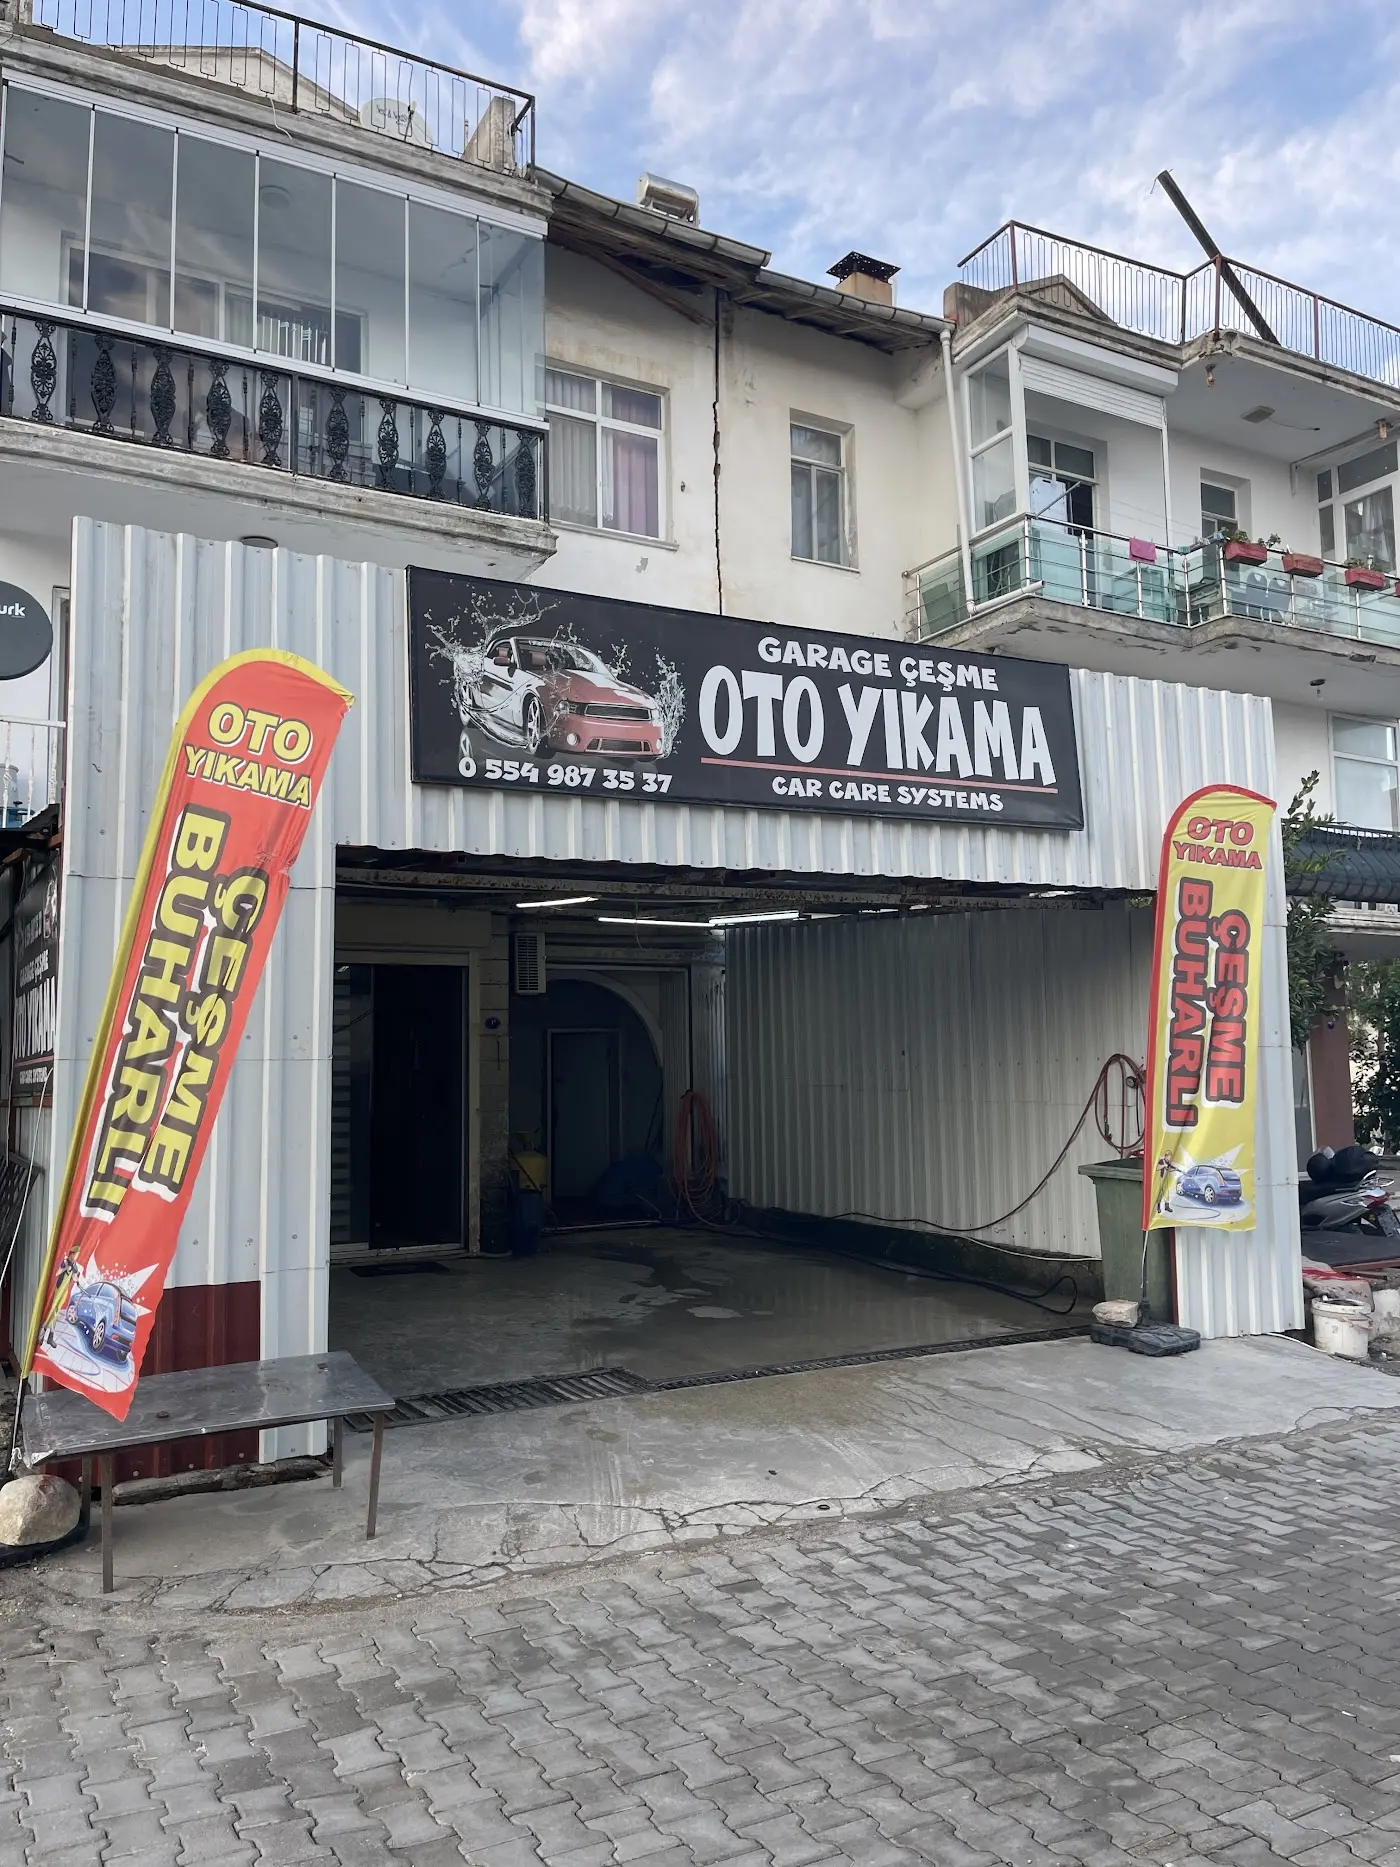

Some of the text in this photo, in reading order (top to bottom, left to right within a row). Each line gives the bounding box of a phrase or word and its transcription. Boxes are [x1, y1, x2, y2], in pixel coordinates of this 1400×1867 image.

[758, 636, 999, 692] GARAGE ÇEŞME
[208, 701, 313, 764] OTO
[699, 665, 1057, 786] OTO YIKAMA
[184, 744, 311, 810] YIKAMA
[458, 756, 673, 794] 0 554 987 35 37
[772, 776, 1004, 812] CAR CARE SYSTEMS
[1172, 840, 1263, 870] YIKAMA
[1187, 816, 1254, 847] OTO
[27, 976, 56, 1057] YIKAMA
[84, 803, 231, 1221] BUHARLI
[137, 866, 269, 1198] ÇEŞME
[1165, 877, 1213, 1128] BUHARLI
[1206, 909, 1251, 1103] ÇEŞME
